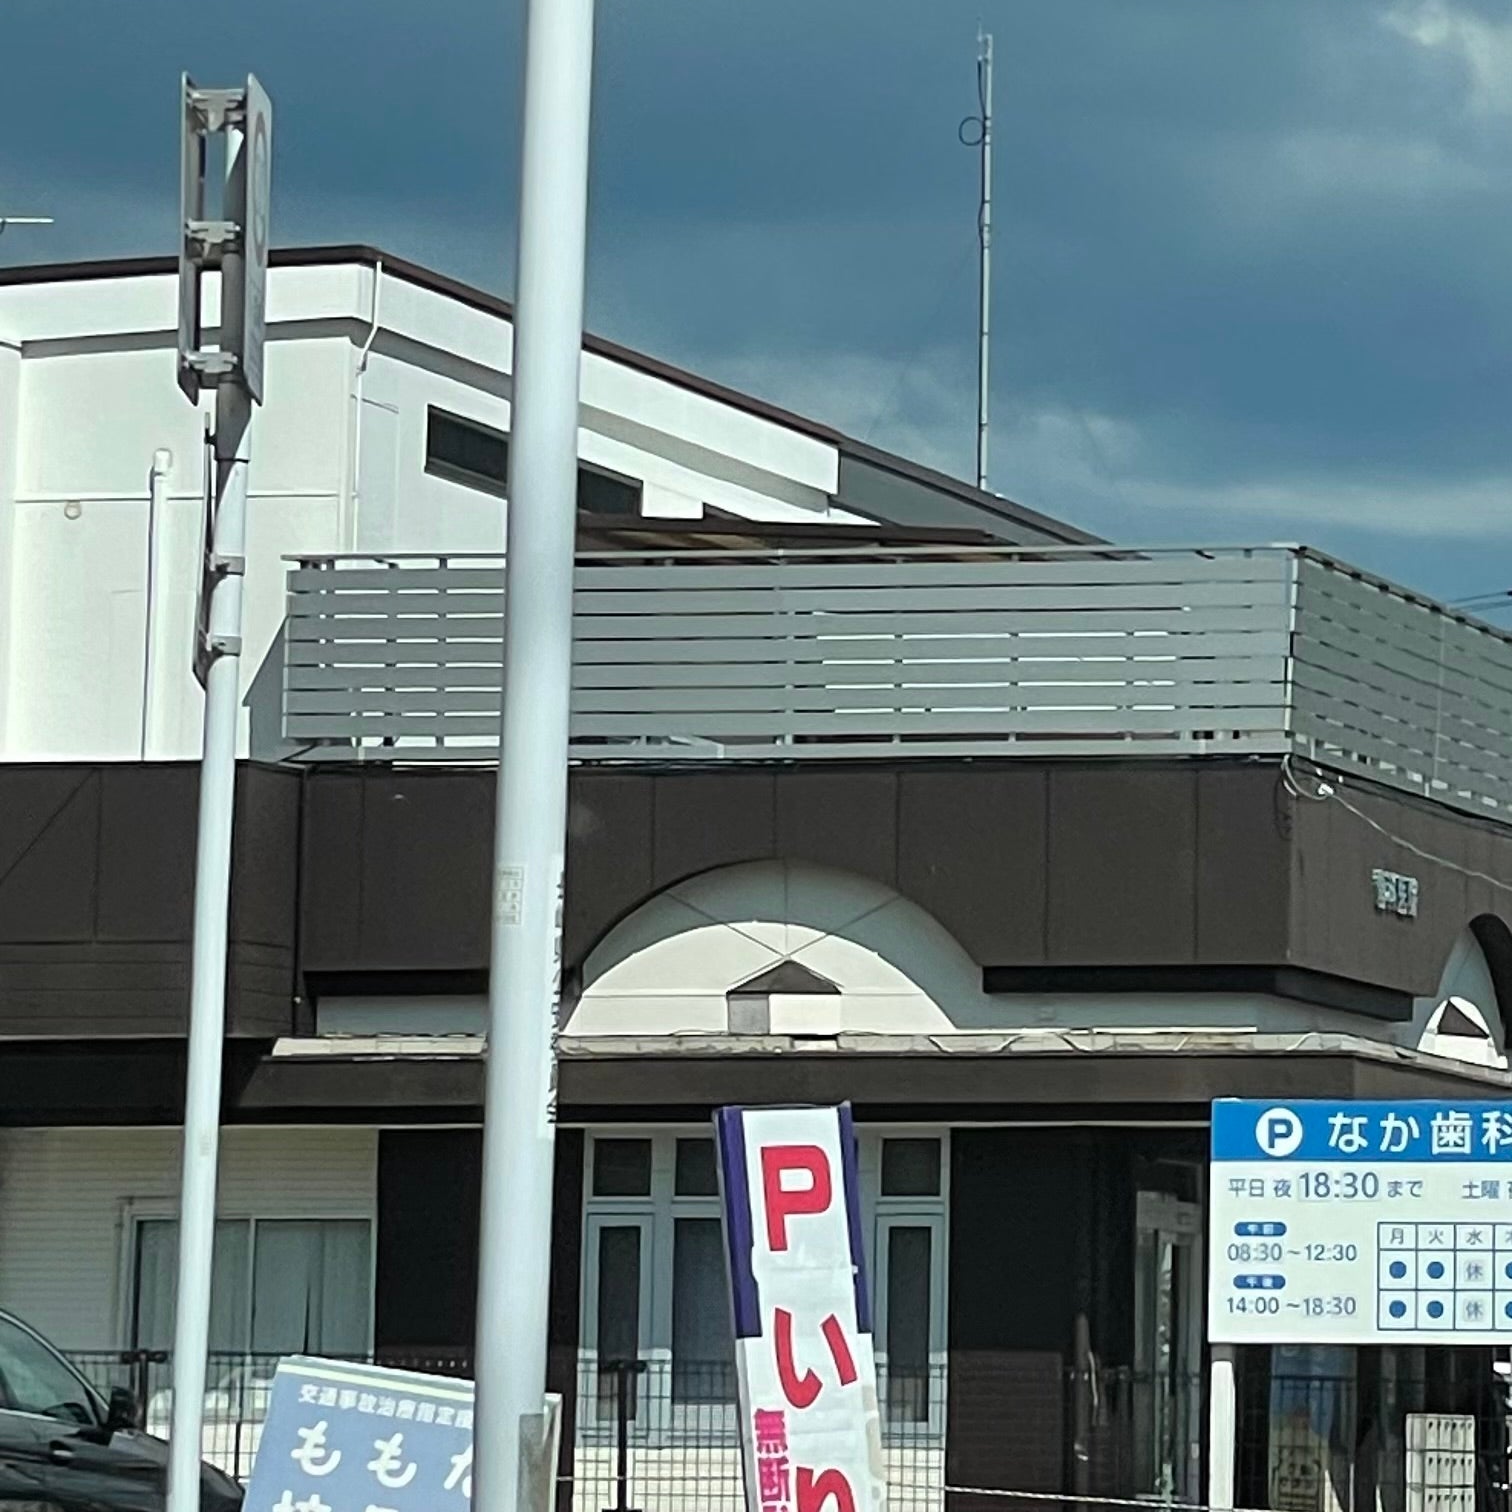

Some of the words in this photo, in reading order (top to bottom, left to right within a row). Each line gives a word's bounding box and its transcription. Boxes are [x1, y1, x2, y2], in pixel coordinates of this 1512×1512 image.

[1228, 1178, 1265, 1198] 平日
[1273, 1178, 1292, 1198] 夜
[1299, 1171, 1380, 1199] 18:30
[1387, 1180, 1424, 1198] まで
[1461, 1179, 1500, 1200] 土曜
[1389, 1227, 1404, 1245] 月
[1428, 1228, 1444, 1245] 火
[1466, 1228, 1483, 1245] 水
[1466, 1260, 1483, 1280] 休
[1465, 1301, 1483, 1319] 休
